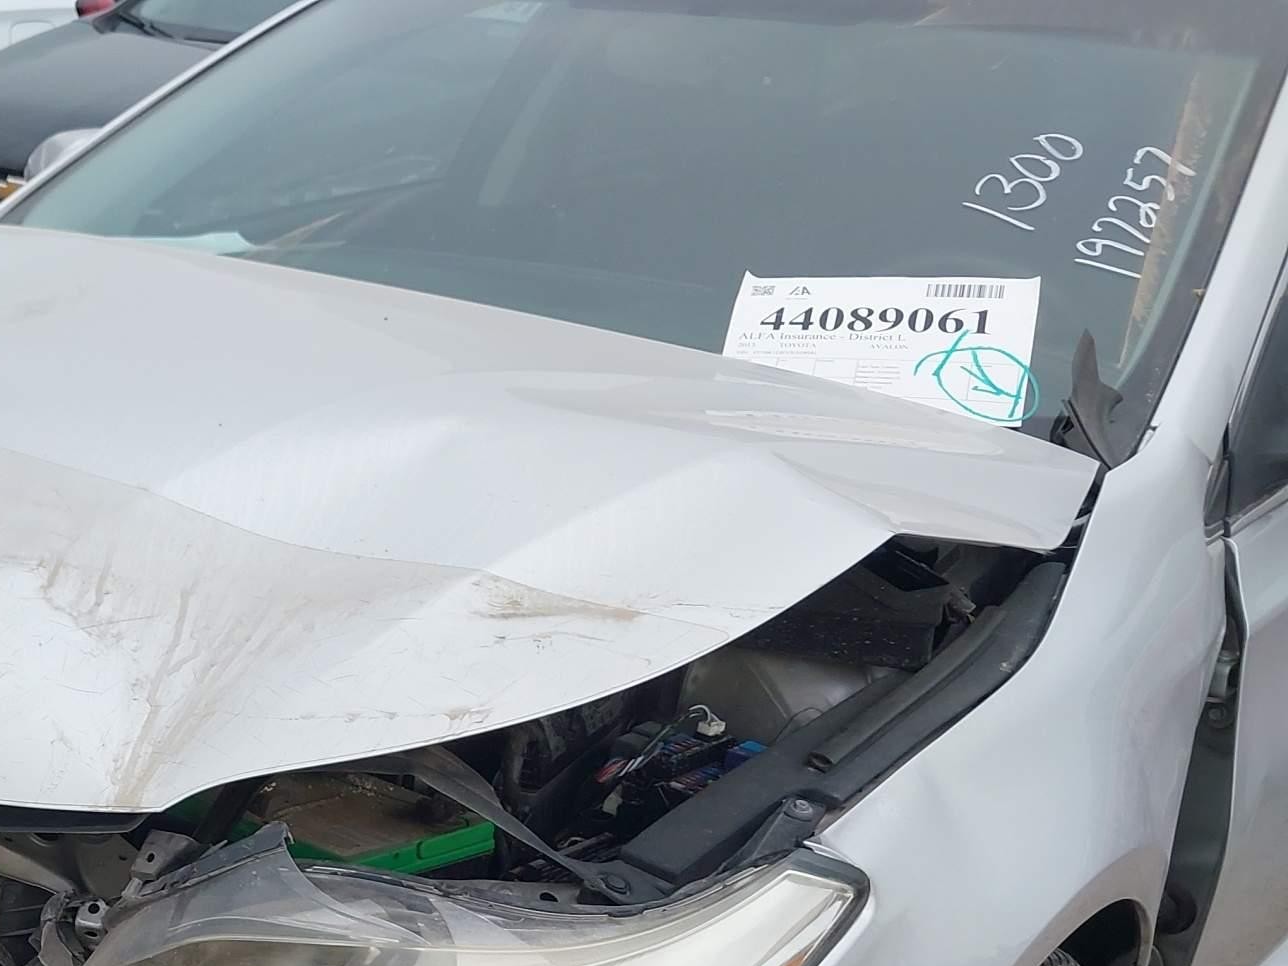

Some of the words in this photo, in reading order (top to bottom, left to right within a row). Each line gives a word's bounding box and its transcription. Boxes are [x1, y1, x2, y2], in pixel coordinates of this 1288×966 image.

[962, 133, 1084, 231] 1300
[759, 306, 991, 335] 44089061
[779, 332, 836, 341] Insurance
[848, 332, 893, 342] District
